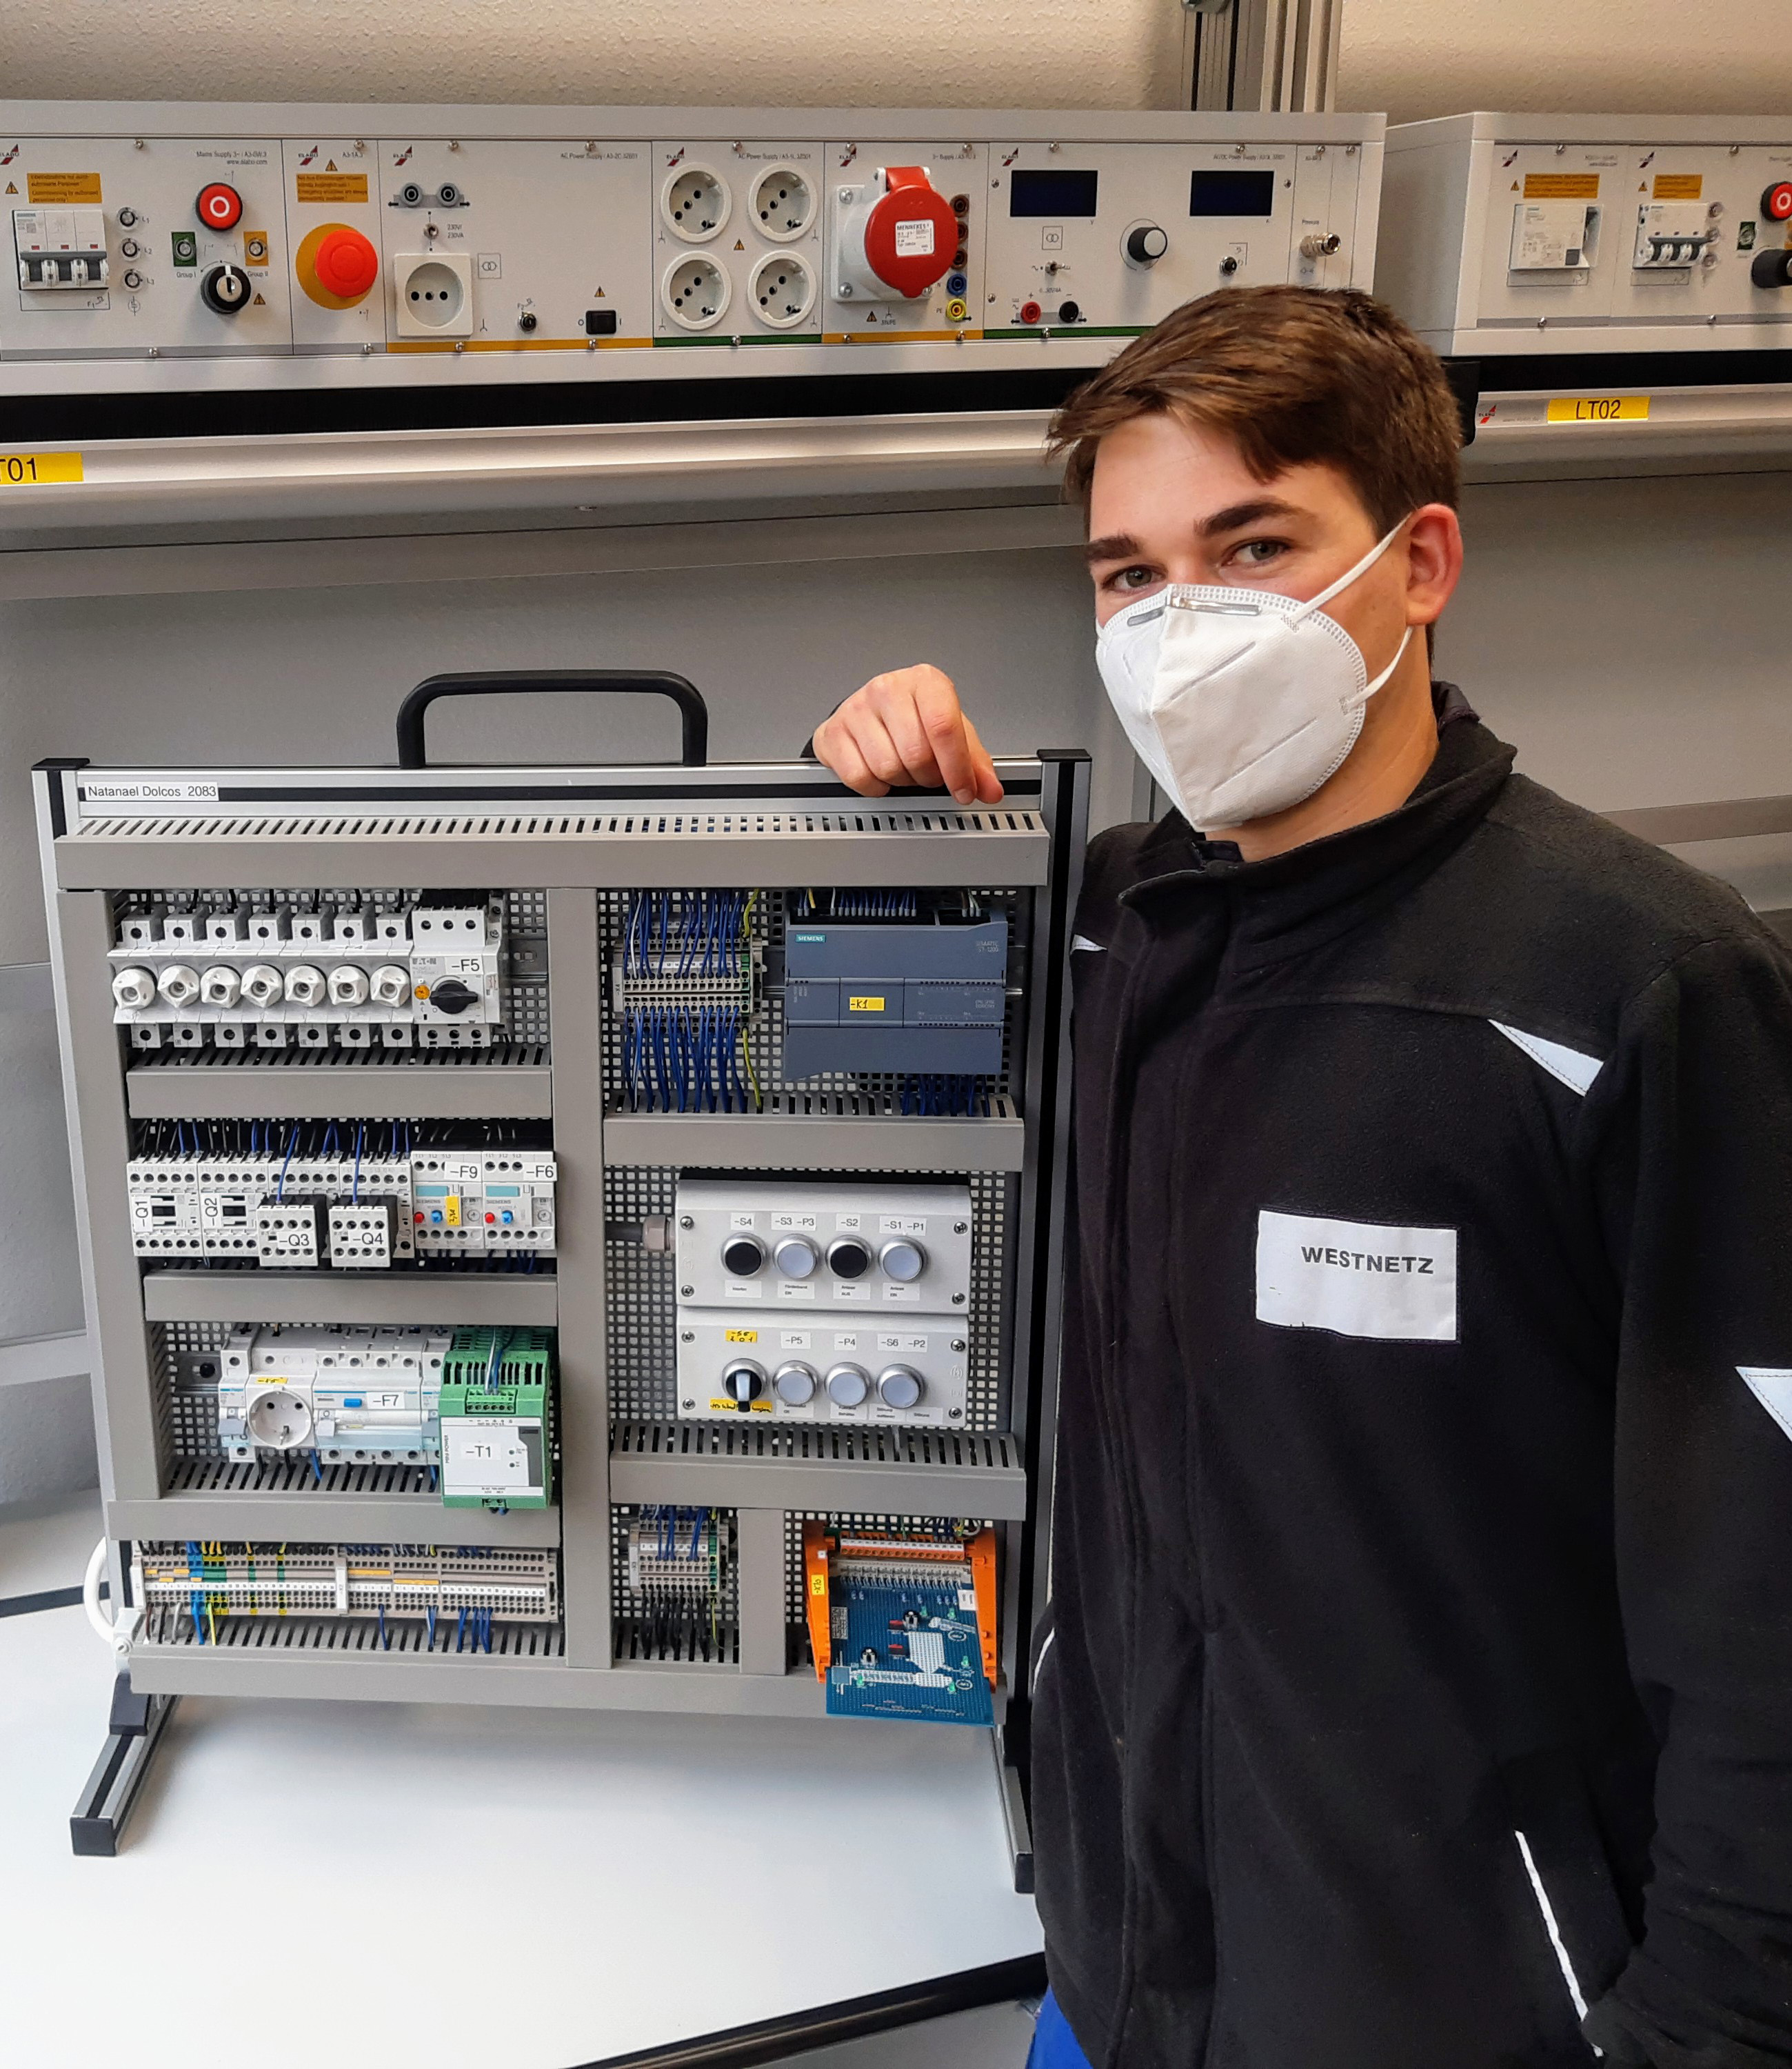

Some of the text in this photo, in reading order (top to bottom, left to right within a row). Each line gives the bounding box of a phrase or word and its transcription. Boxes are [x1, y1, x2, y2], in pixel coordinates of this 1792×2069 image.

[1575, 399, 1621, 419] LT02
[88, 786, 217, 797] Natanael Dolcos 2083
[451, 959, 480, 972] -F5
[851, 999, 868, 1009] -K1
[450, 1166, 478, 1179] -F9
[526, 1165, 554, 1178] -F6
[135, 1201, 149, 1227] -Q1
[204, 1197, 219, 1226] -Q2
[734, 1217, 752, 1226] -S4
[775, 1217, 815, 1226] -S3 -P3
[840, 1218, 858, 1227] -S2
[884, 1221, 925, 1231] -S1 -P1
[279, 1233, 310, 1246] -Q3
[352, 1232, 384, 1245] -Q4
[1301, 1246, 1434, 1275] WESTNETZ
[785, 1336, 803, 1345] -P5
[838, 1338, 856, 1346] -P4
[881, 1339, 925, 1348] -S6 -P2
[373, 1394, 399, 1407] -F7
[465, 1446, 491, 1458] -T1
